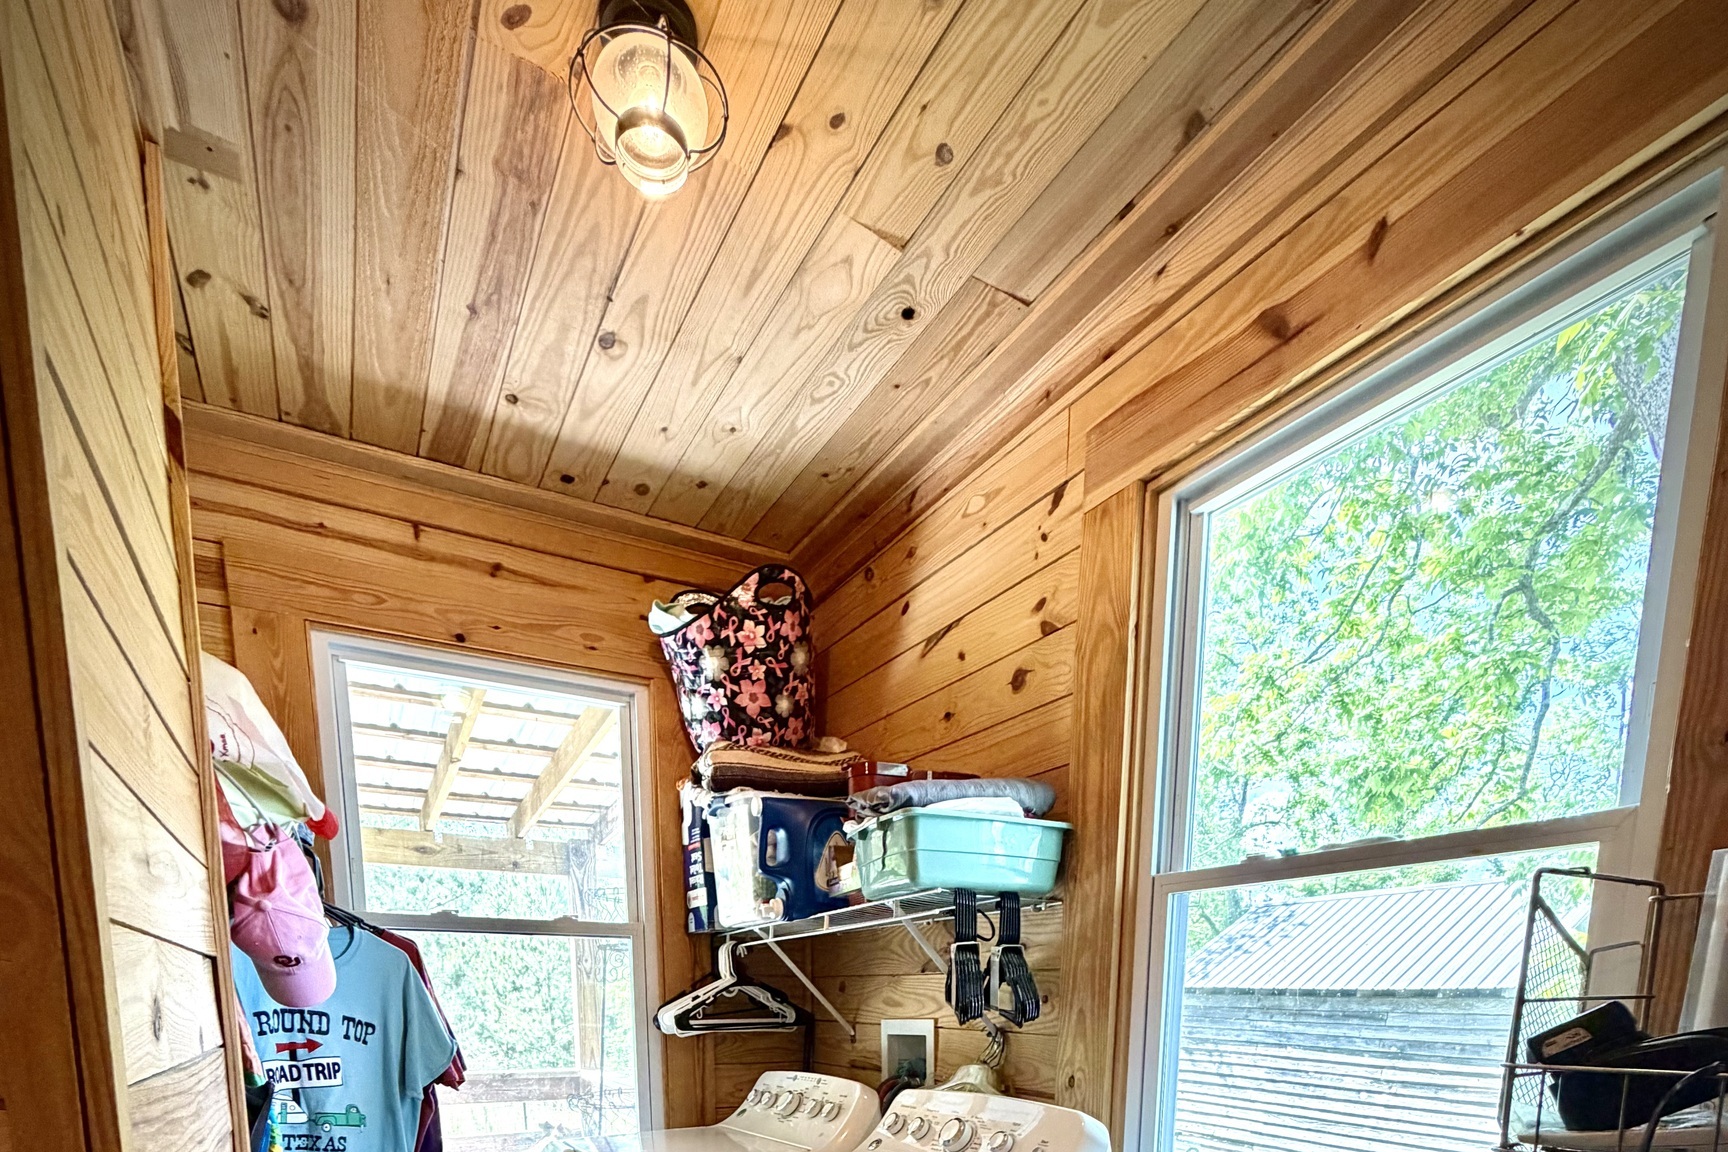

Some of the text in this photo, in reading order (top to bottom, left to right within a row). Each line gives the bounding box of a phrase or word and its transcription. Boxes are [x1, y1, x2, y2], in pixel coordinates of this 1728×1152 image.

[252, 1008, 376, 1046] ROUND TOP
[302, 1061, 341, 1081] TRIP
[282, 1134, 347, 1152] TEXAS
